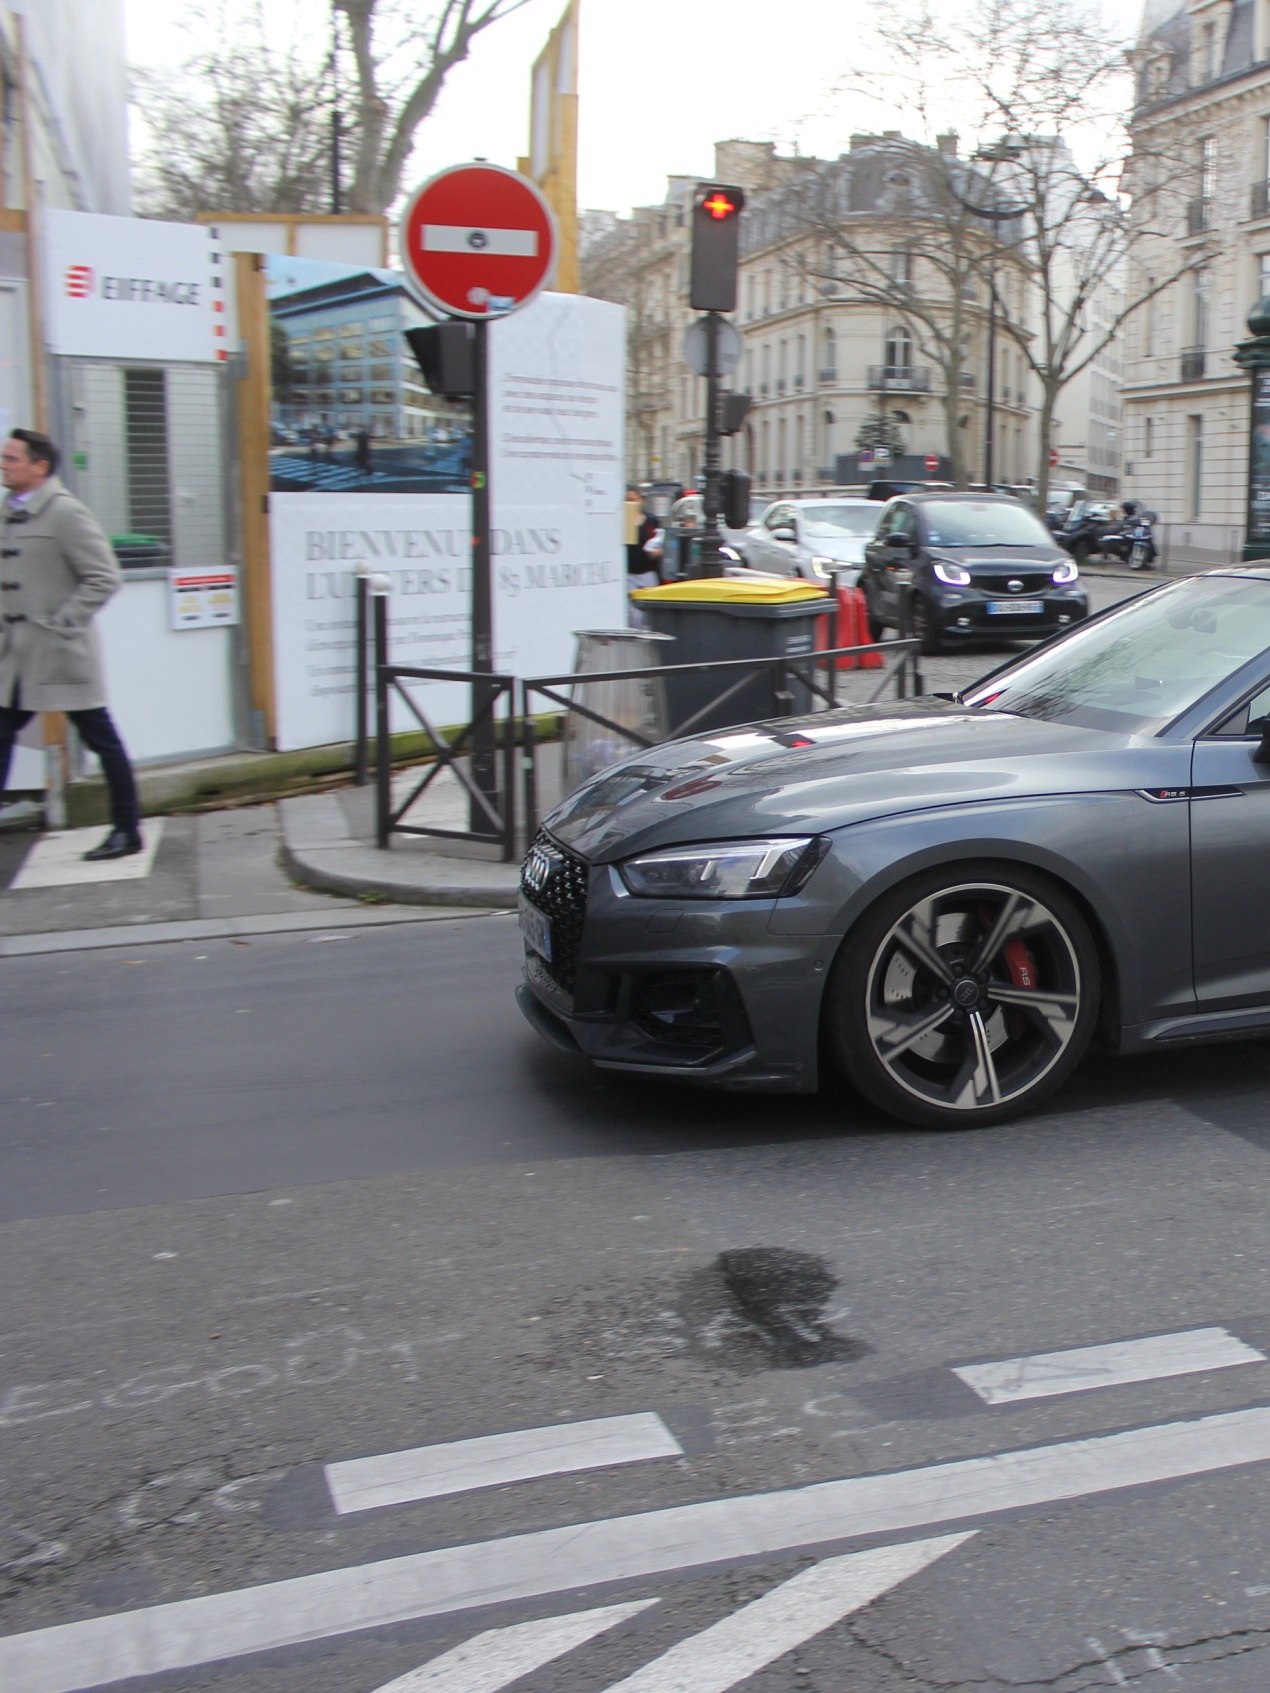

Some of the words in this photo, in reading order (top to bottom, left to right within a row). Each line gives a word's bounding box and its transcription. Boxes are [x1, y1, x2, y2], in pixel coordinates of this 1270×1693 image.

[101, 276, 202, 305] EIFFAGE
[305, 529, 473, 560] BIENVENU
[489, 528, 562, 555] DANS
[1019, 967, 1031, 986] RS
